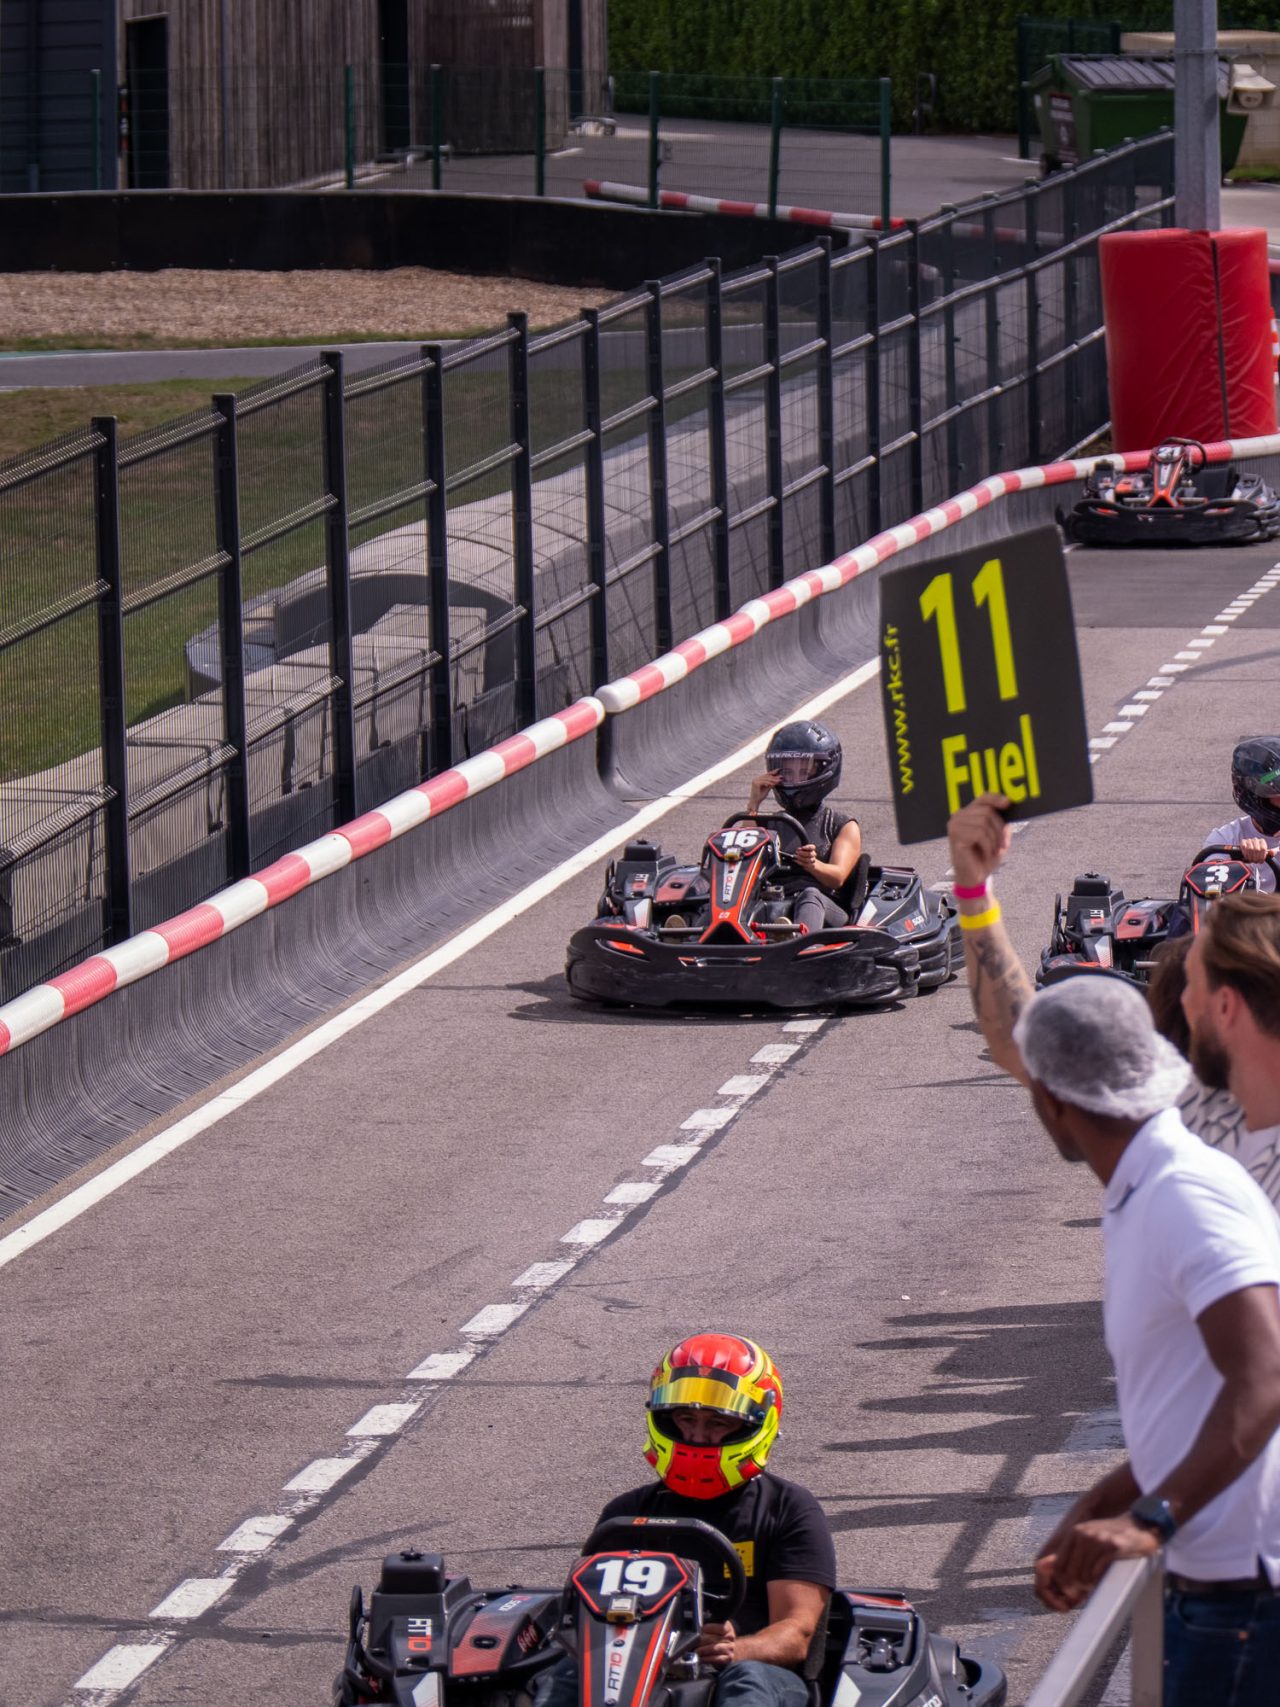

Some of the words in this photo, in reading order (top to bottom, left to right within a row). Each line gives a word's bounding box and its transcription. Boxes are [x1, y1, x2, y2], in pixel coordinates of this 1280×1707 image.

[919, 558, 1018, 714] 11
[883, 624, 914, 794] www.rkc.fr
[941, 713, 1040, 815] Fuel
[721, 830, 760, 848] 16
[1205, 865, 1230, 883] 3
[595, 1559, 666, 1596] 19
